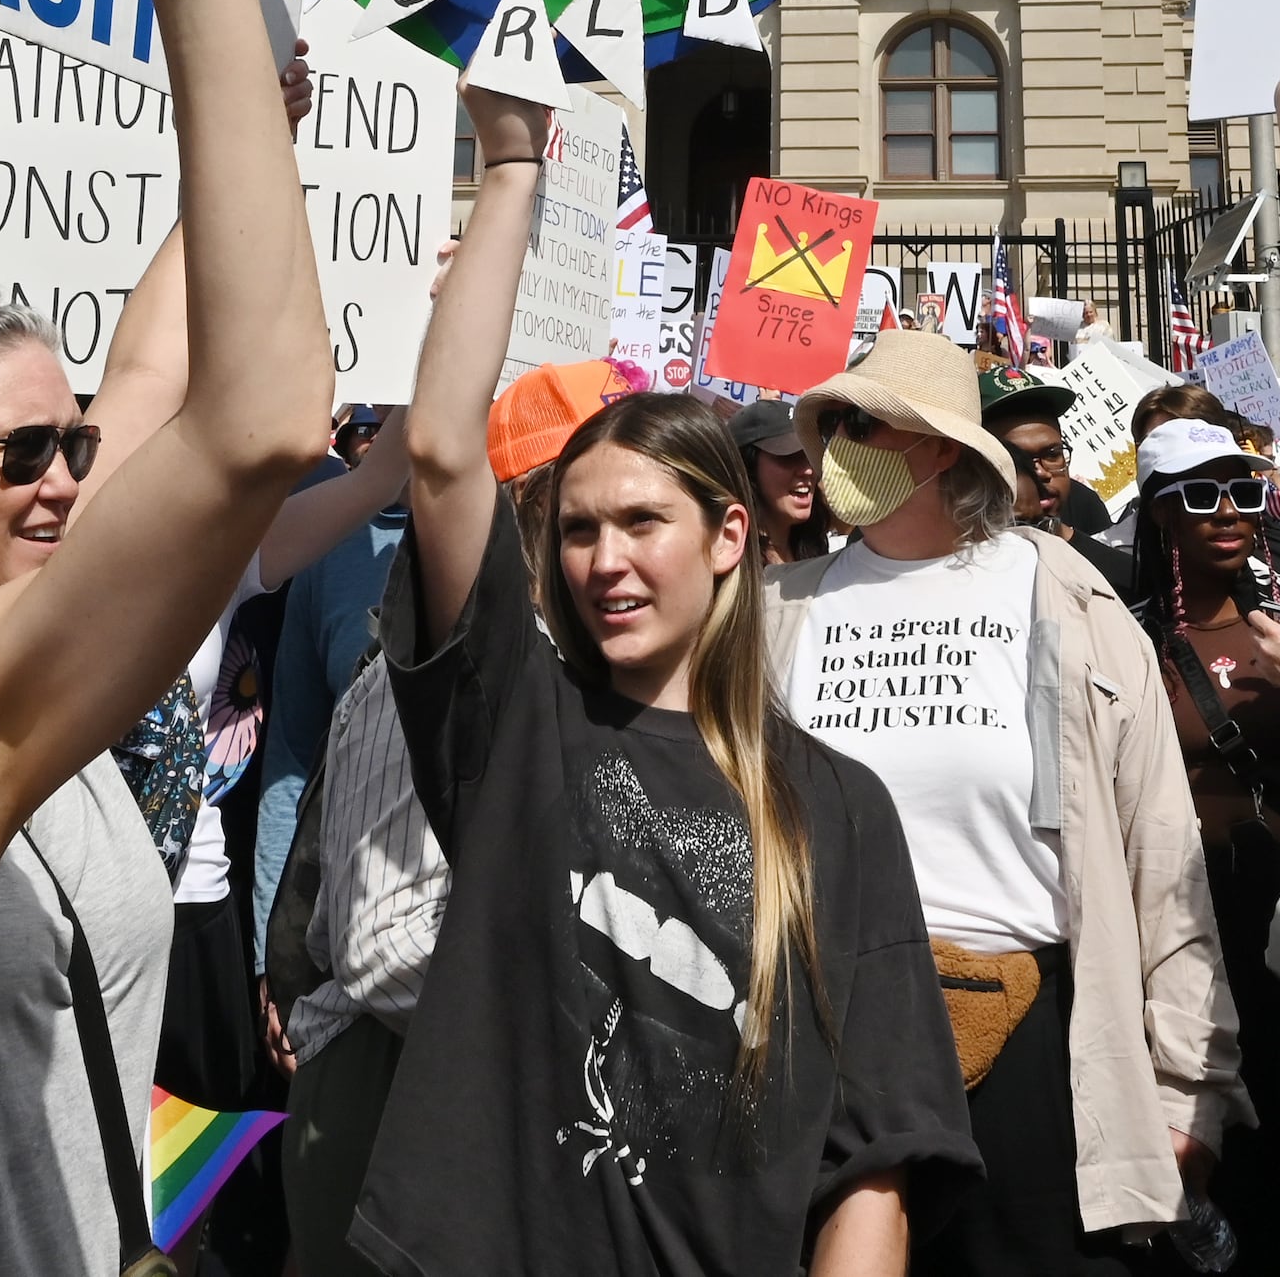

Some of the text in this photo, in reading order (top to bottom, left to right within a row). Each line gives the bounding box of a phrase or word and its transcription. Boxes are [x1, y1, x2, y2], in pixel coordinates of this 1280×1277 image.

[562, 130, 615, 173] ASIER TO
[538, 159, 607, 208] ACEFULLY
[755, 181, 863, 229] NO Kings
[572, 207, 610, 246] TODAY
[615, 233, 661, 257] of the
[569, 247, 597, 279] HIDE
[580, 291, 610, 320] ATTIC
[757, 293, 815, 322] Since
[513, 308, 593, 354] TOMORROW
[756, 316, 812, 347] 1776
[616, 343, 652, 360] WER
[1061, 361, 1094, 390] THE
[1103, 392, 1125, 412] NO
[1085, 418, 1126, 453] KING
[825, 615, 1021, 645] It's a great day
[821, 643, 978, 673] to stand for
[815, 673, 969, 704] EQUALITY
[808, 703, 1008, 733] and JUSTICE.
